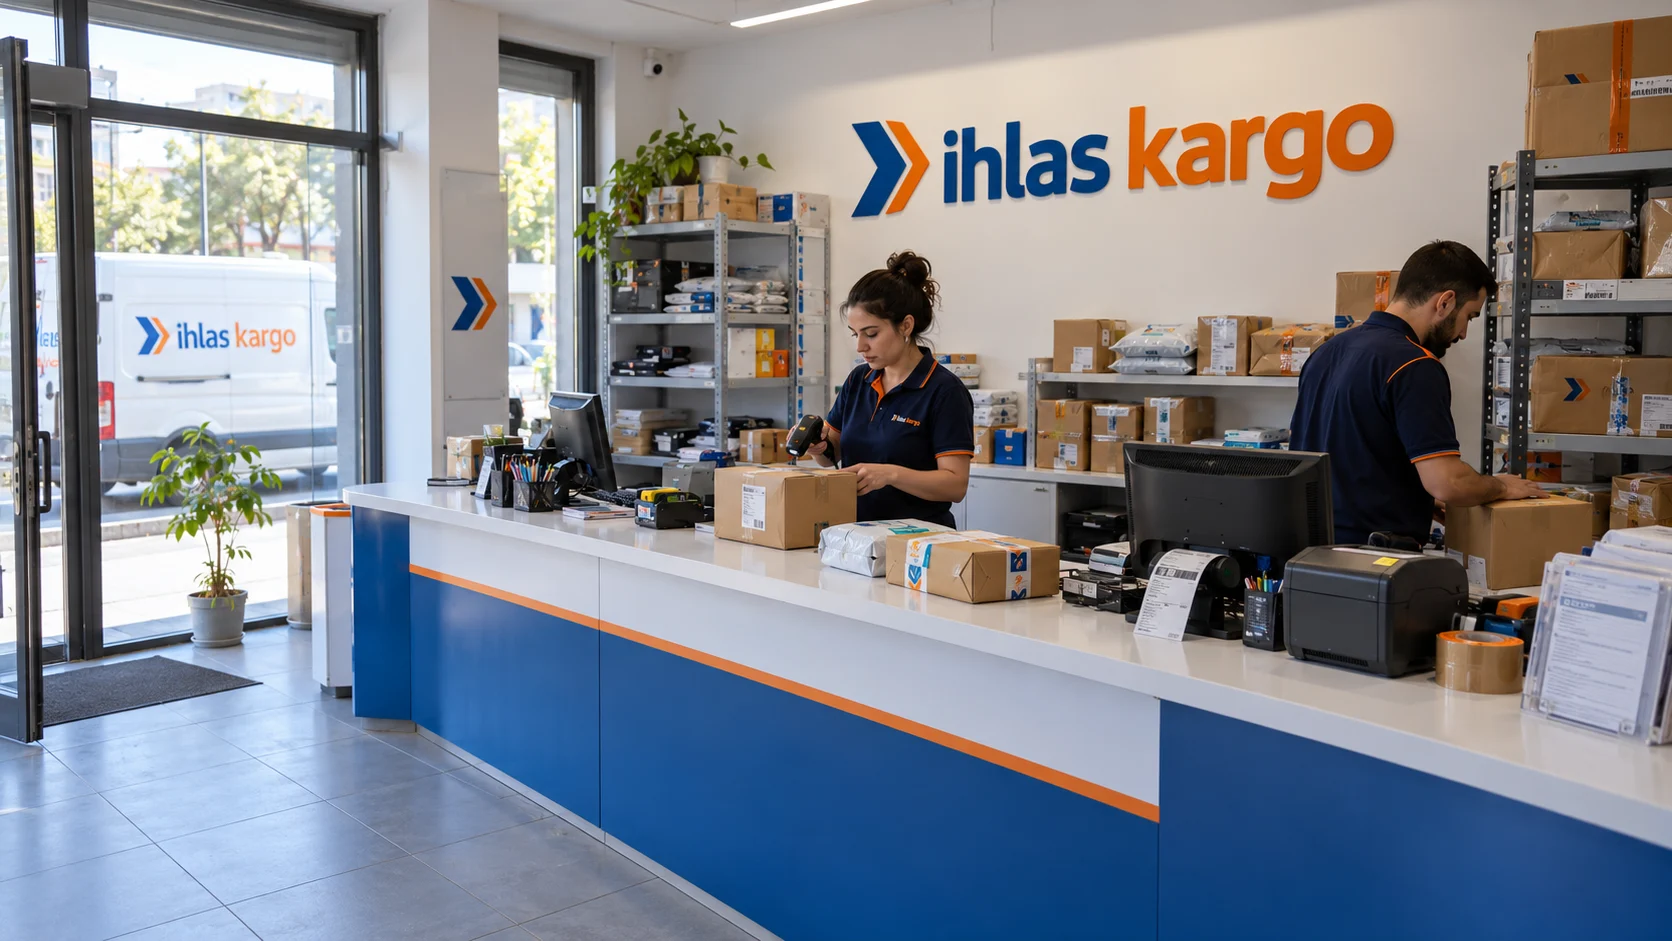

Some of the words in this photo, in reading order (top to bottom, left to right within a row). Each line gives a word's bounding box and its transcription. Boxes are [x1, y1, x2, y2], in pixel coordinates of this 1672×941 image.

[943, 121, 1110, 204] ihlas
[1127, 102, 1395, 200] kargo
[176, 322, 230, 349] ihlas
[235, 322, 296, 353] kargo
